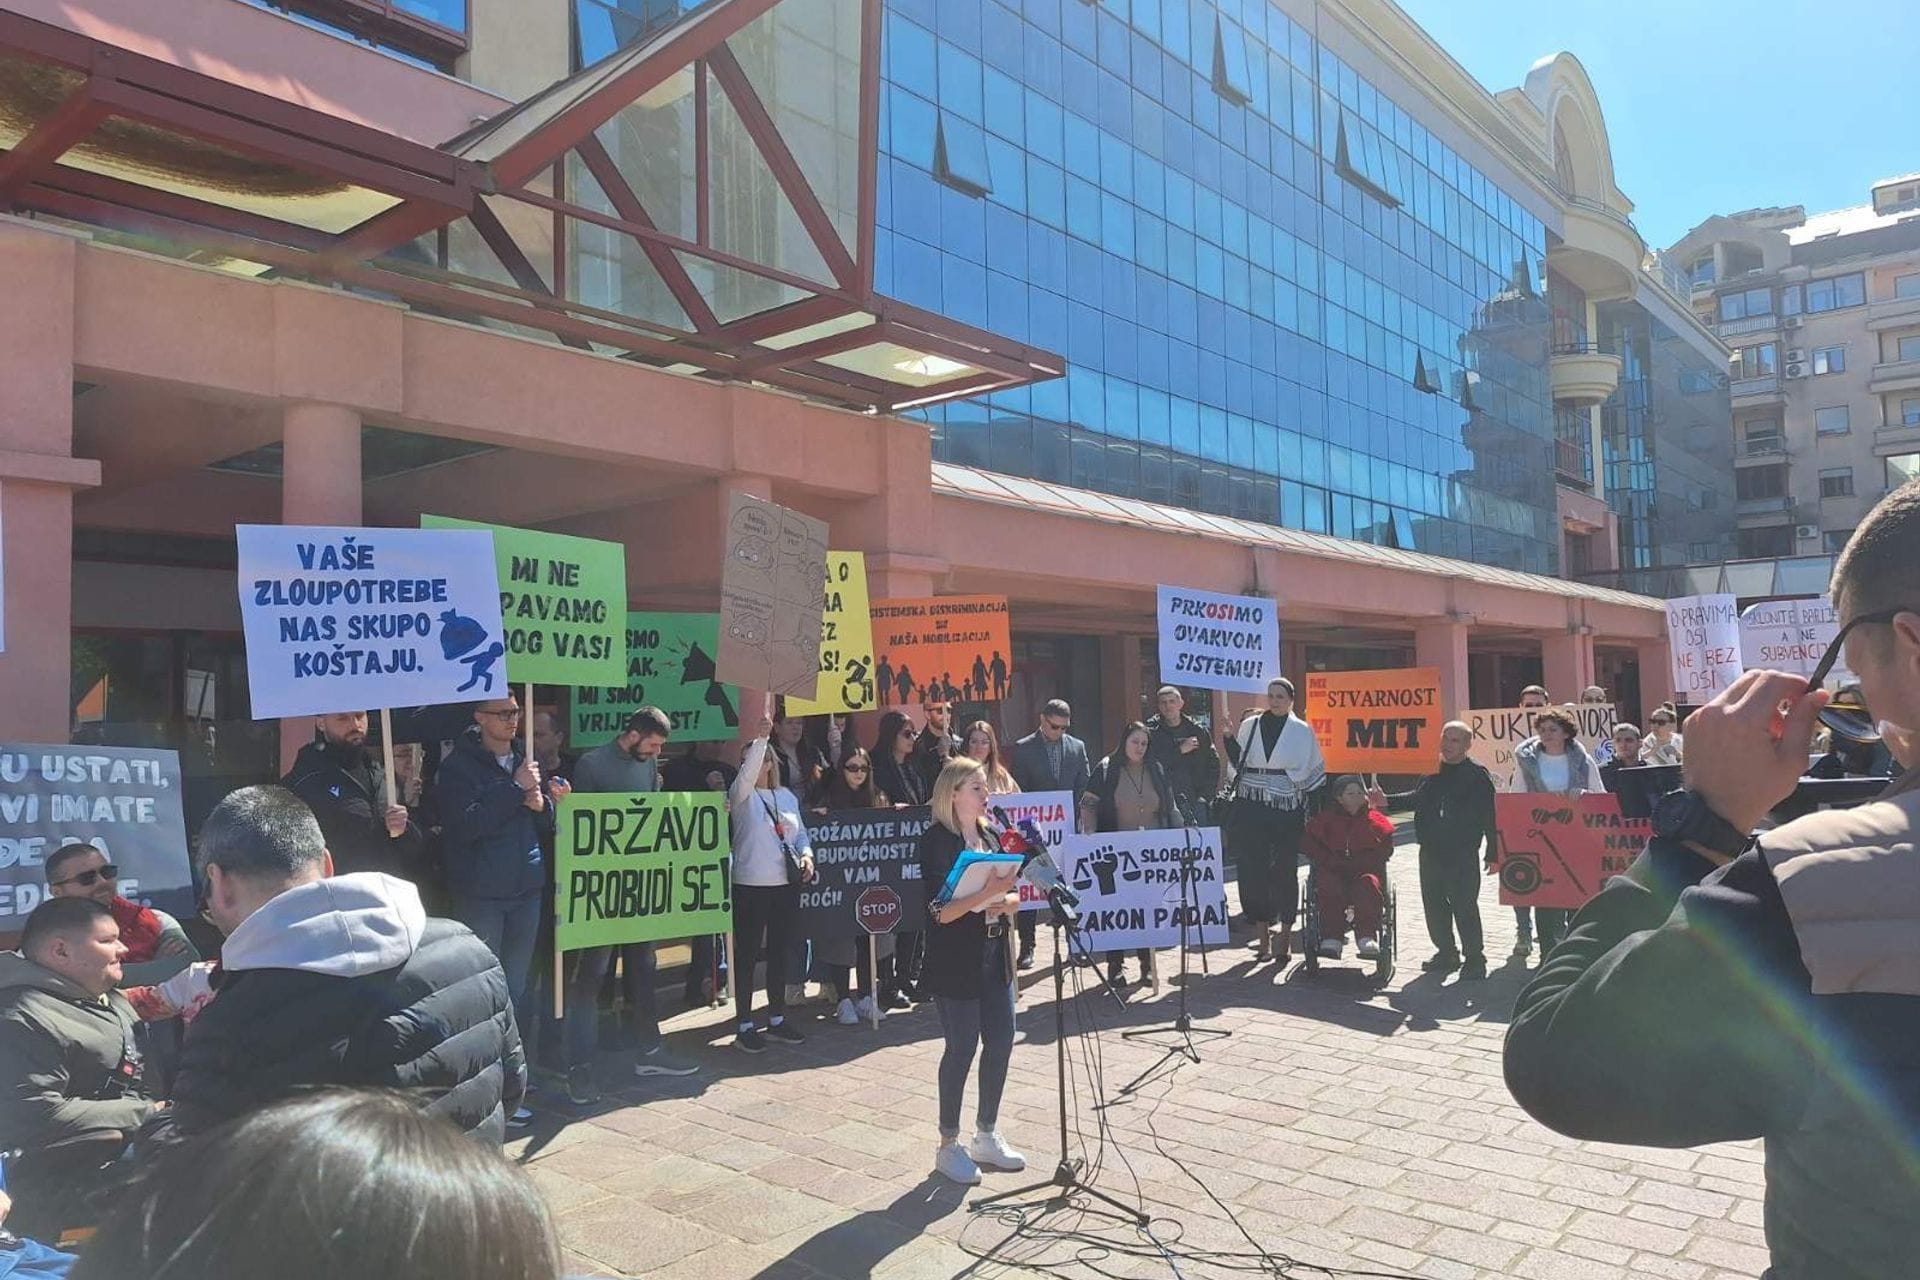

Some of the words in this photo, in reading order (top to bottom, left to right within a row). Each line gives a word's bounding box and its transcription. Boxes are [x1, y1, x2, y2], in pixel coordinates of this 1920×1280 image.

[297, 536, 375, 570] VAŠE
[511, 556, 539, 583] MI
[549, 560, 580, 587] NE
[839, 562, 849, 581] O
[254, 578, 448, 606] ZLOUPOTREBE
[930, 602, 1007, 616] DISKRIMINACIJA
[1171, 597, 1263, 624] PRKOSIMO
[1681, 603, 1737, 626] PRAVIMA
[280, 615, 337, 642] NAS
[348, 612, 431, 640] SKUPO
[890, 632, 918, 646] NAŠA
[922, 631, 991, 644] MOBILIZACIJA
[1174, 624, 1262, 650] OVAKVOM
[1686, 628, 1708, 646] OSI
[1801, 628, 1816, 641] NE
[553, 632, 612, 660] VAS!
[1677, 653, 1693, 669] NE
[1706, 647, 1738, 666] BEZ
[294, 643, 424, 678] KOŠTAJU.
[626, 652, 658, 678] AK,
[820, 650, 840, 672] S!
[1175, 653, 1263, 679] SISTEMU!
[1689, 670, 1716, 691] OSI
[1327, 687, 1436, 708] STVARNOST
[1346, 718, 1426, 748] MIT
[1, 753, 28, 783] U
[41, 755, 169, 789] USTATI,
[0, 793, 38, 824] VI
[52, 794, 157, 824] IMATE
[573, 797, 719, 857] DRŽAVO
[816, 841, 916, 864] BUDUĆNOST!
[1141, 846, 1215, 863] SLOBODA
[680, 857, 731, 913] SE!
[844, 866, 880, 884] VAM
[902, 863, 922, 880] NE
[862, 902, 897, 916] STOP
